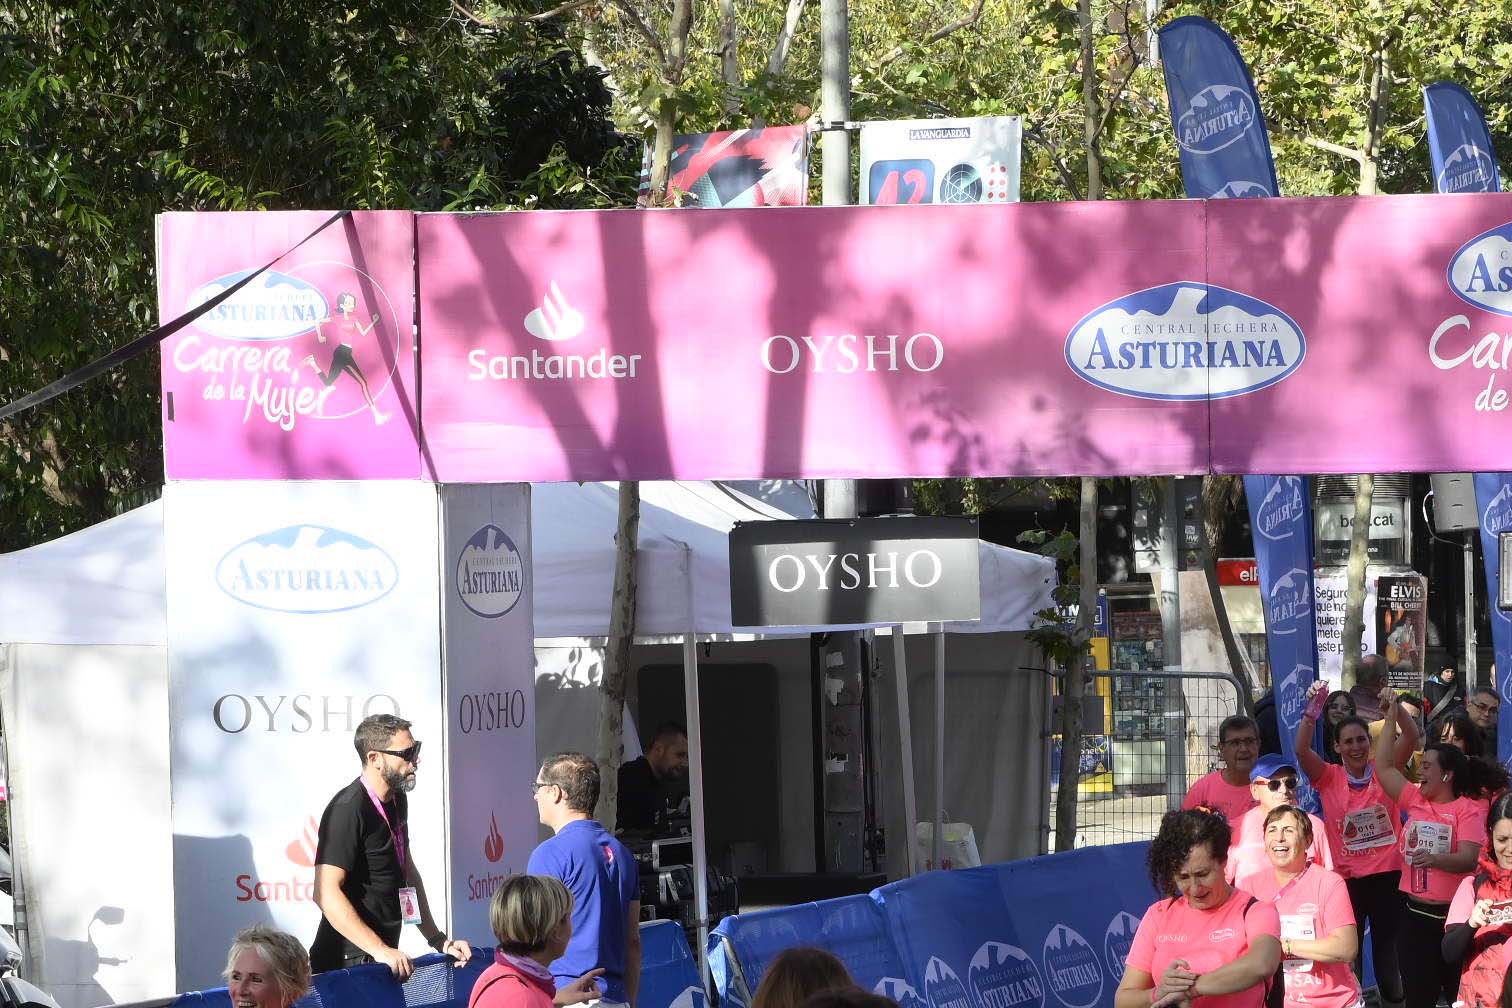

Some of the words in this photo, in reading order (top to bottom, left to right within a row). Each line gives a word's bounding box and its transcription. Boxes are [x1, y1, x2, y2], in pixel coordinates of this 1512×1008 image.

[919, 128, 970, 139] VANGUARDIA
[1121, 322, 1195, 336] CENTRAL
[1204, 320, 1279, 335] LECHERA
[174, 336, 294, 374] Carrera
[468, 348, 642, 381] Santander
[760, 332, 945, 375] OYSHO
[1084, 326, 1288, 371] ASTURIANA
[203, 376, 225, 400] de
[229, 377, 245, 400] la
[243, 367, 336, 432] Mujer
[1474, 373, 1509, 411] de
[231, 559, 385, 592] ASTURIANA
[461, 560, 520, 595] ASTURIANA
[768, 549, 942, 593] OYSHO
[1391, 585, 1421, 598] ELVIS
[459, 689, 526, 734] OYSHO
[1358, 823, 1375, 833] 016
[1419, 839, 1434, 848] 016
[1051, 962, 1100, 993] ASTURIANA
[1284, 972, 1322, 988] RSAL
